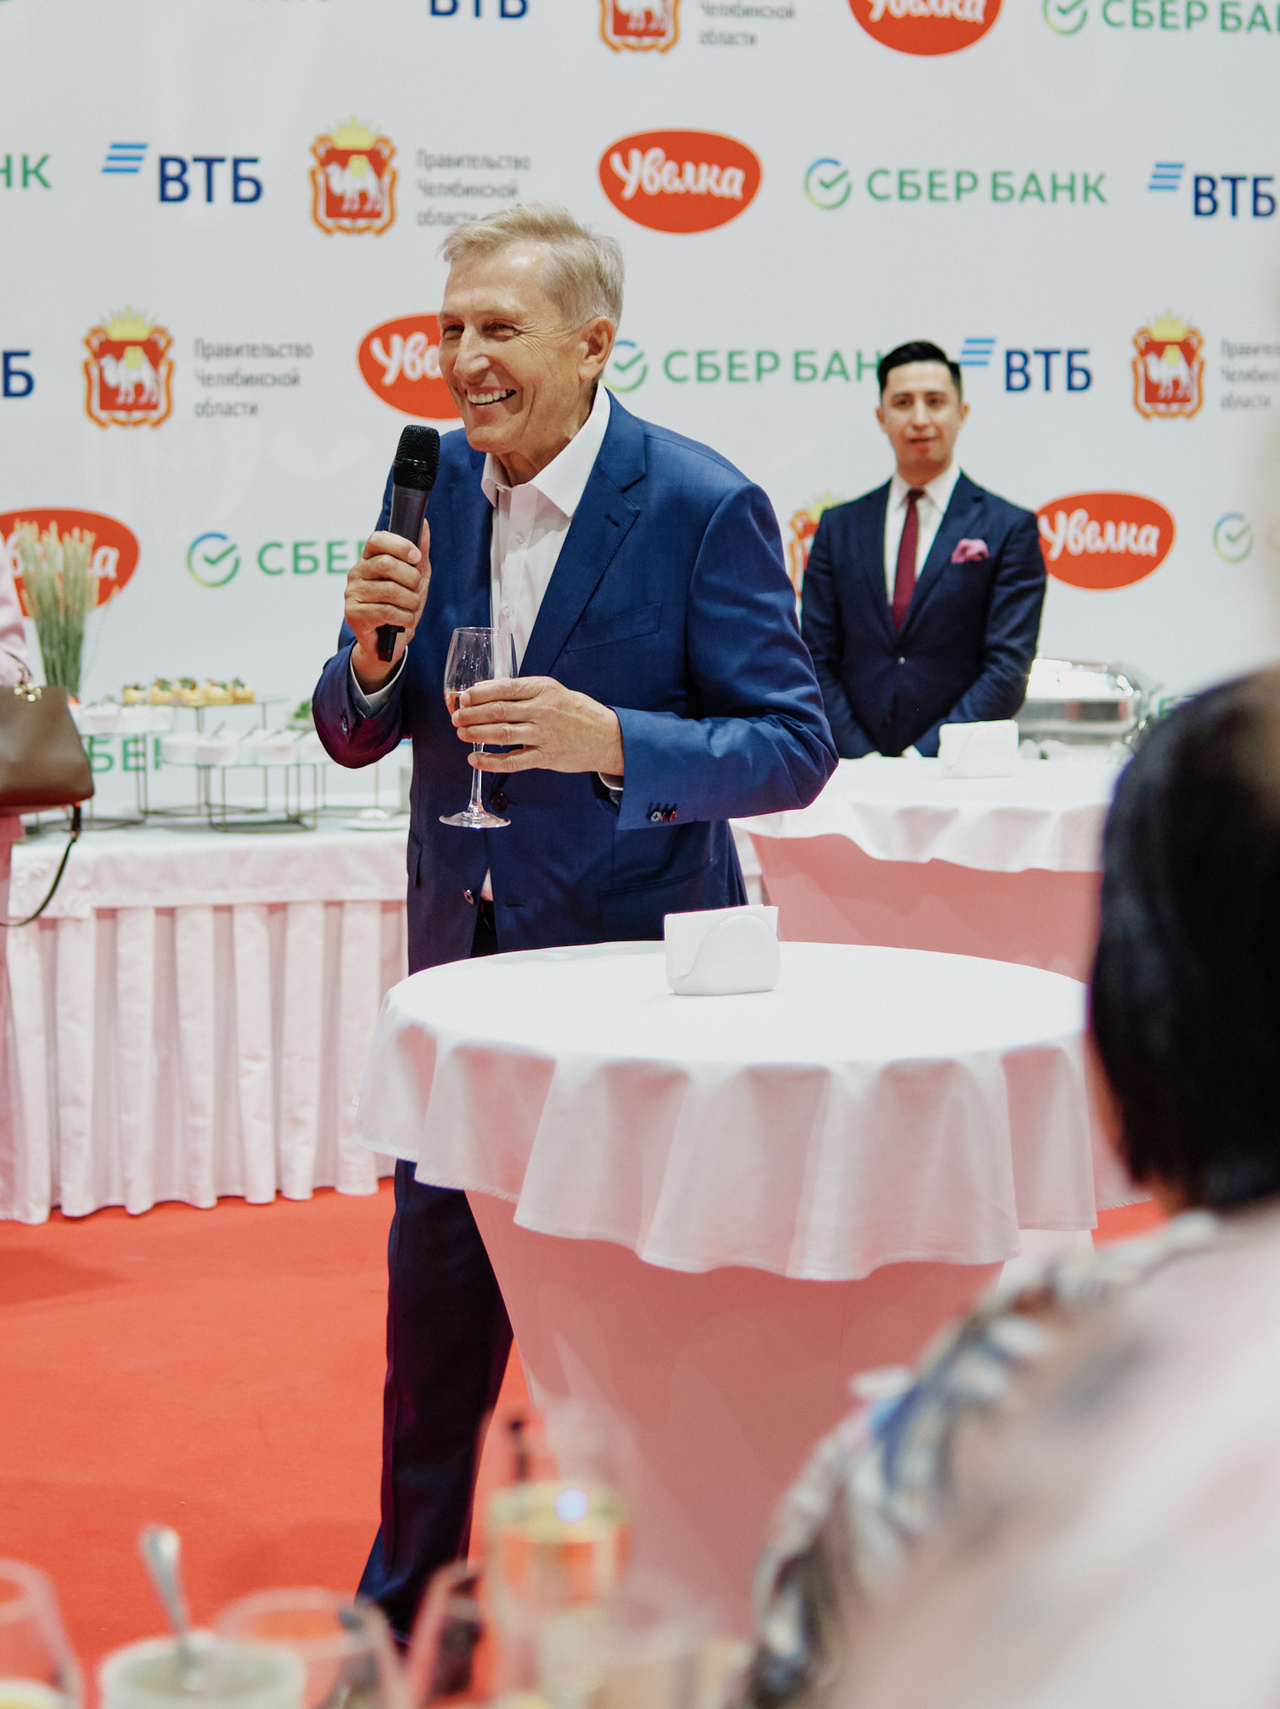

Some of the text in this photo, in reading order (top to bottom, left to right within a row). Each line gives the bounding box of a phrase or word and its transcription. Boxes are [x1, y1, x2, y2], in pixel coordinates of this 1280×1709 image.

[1101, 0, 1280, 33] СБЕР БА
[159, 156, 263, 203] ВТБ
[608, 147, 746, 200] Увелка
[867, 169, 1108, 205] СБЕР БАНК
[1194, 175, 1276, 218] ВТБ
[370, 332, 442, 386] Уве
[664, 350, 888, 383] СБЕР БАН
[1006, 350, 1092, 393] ВТБ
[1038, 508, 1160, 561] Увелка
[257, 540, 368, 576] СБЕ
